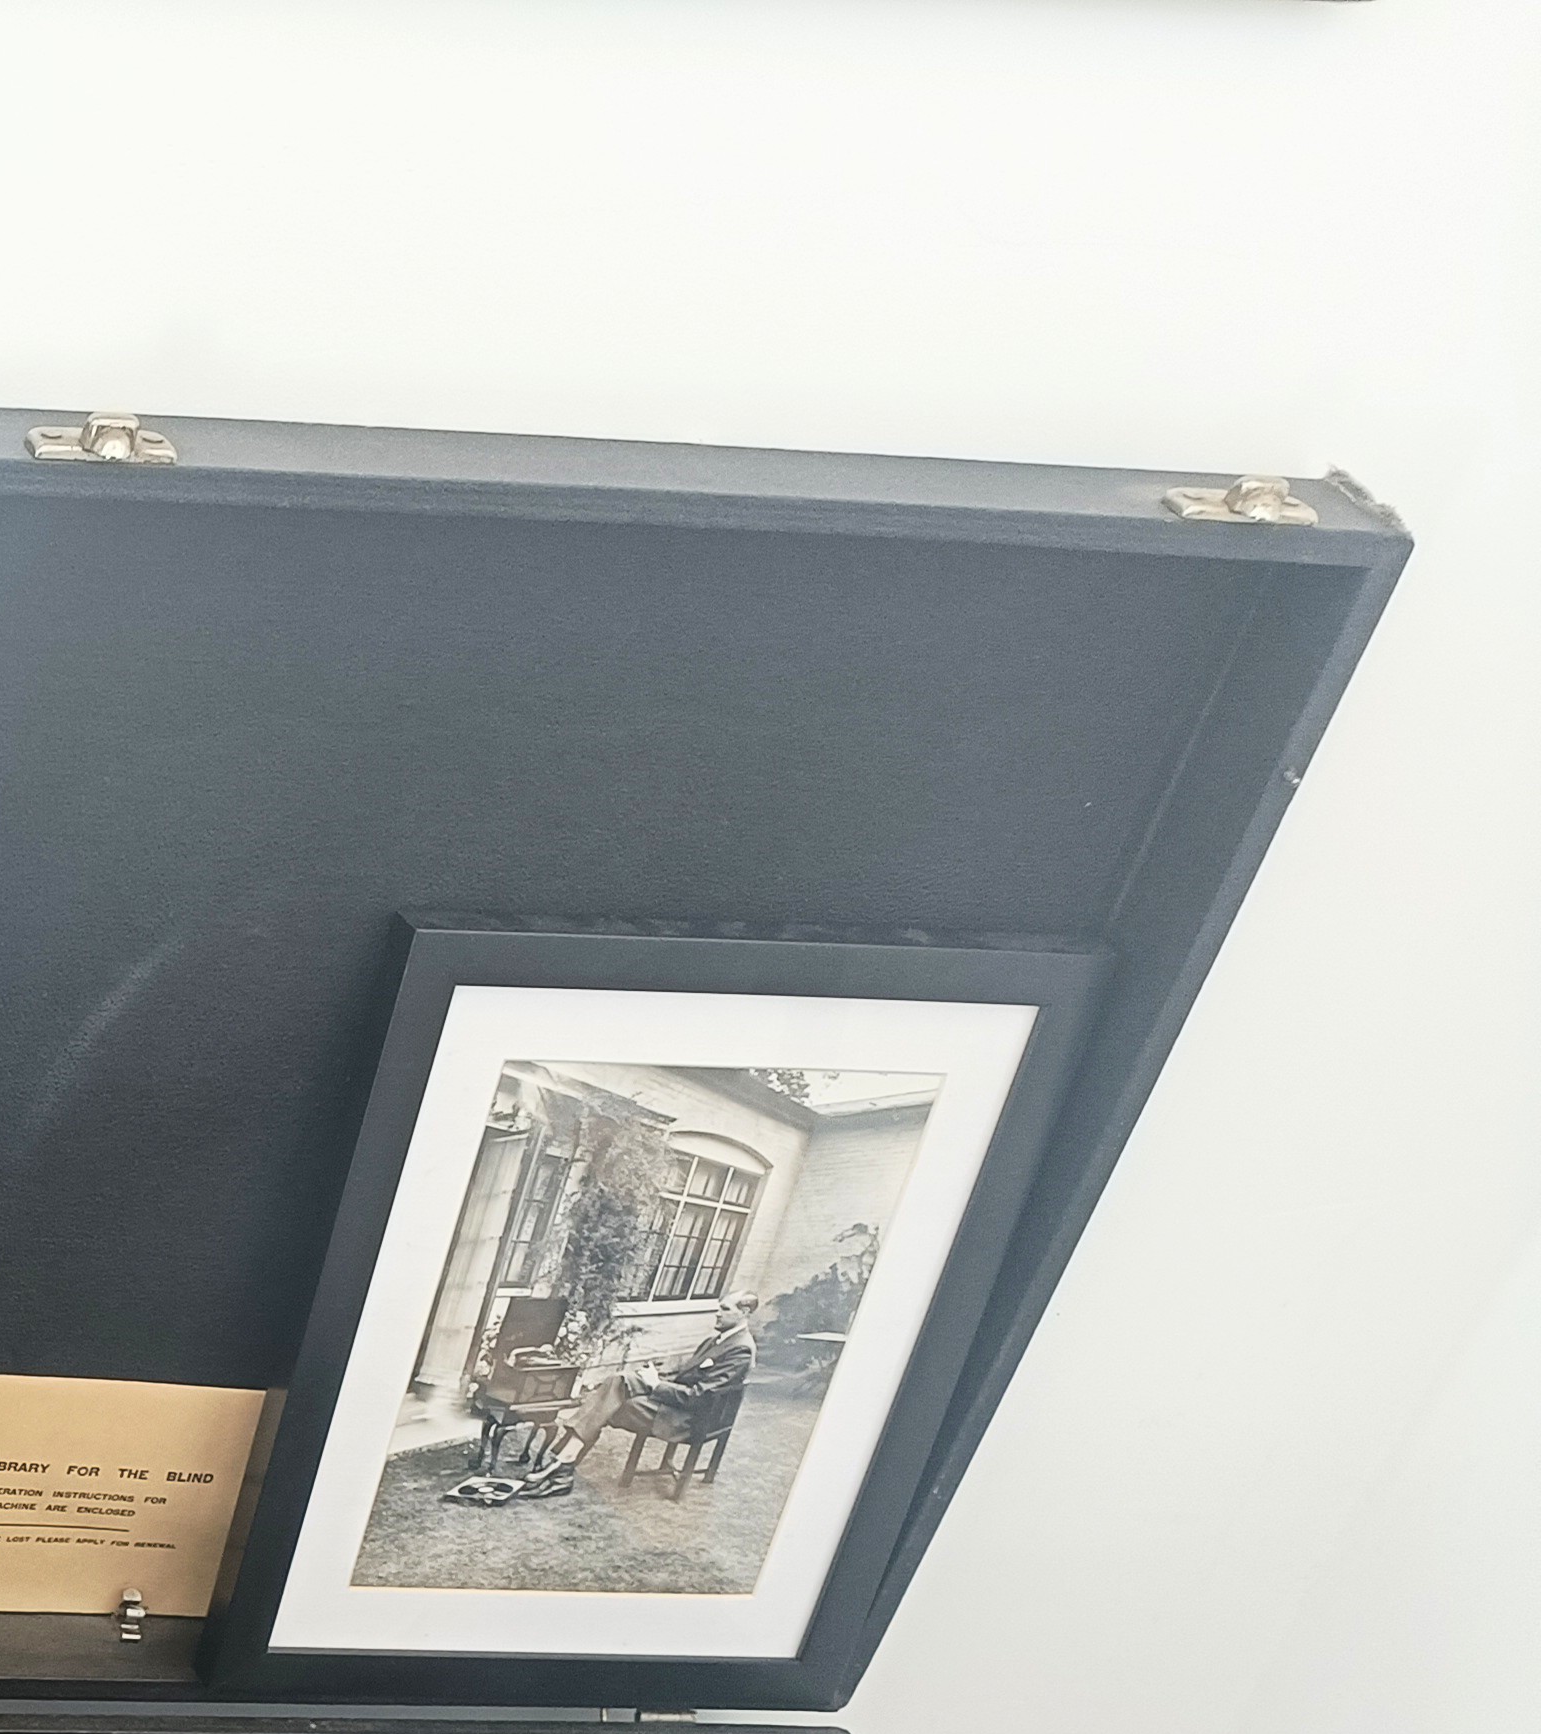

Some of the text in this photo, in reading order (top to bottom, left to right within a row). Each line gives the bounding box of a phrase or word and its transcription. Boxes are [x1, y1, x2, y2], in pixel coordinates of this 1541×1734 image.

[66, 1465, 100, 1476] FOR
[118, 1468, 149, 1479] THE
[166, 1471, 213, 1483] BLIND
[52, 1491, 134, 1502] INSTRUCTIONS
[143, 1496, 166, 1504] FOR
[76, 1506, 135, 1516] ENCLOSED
